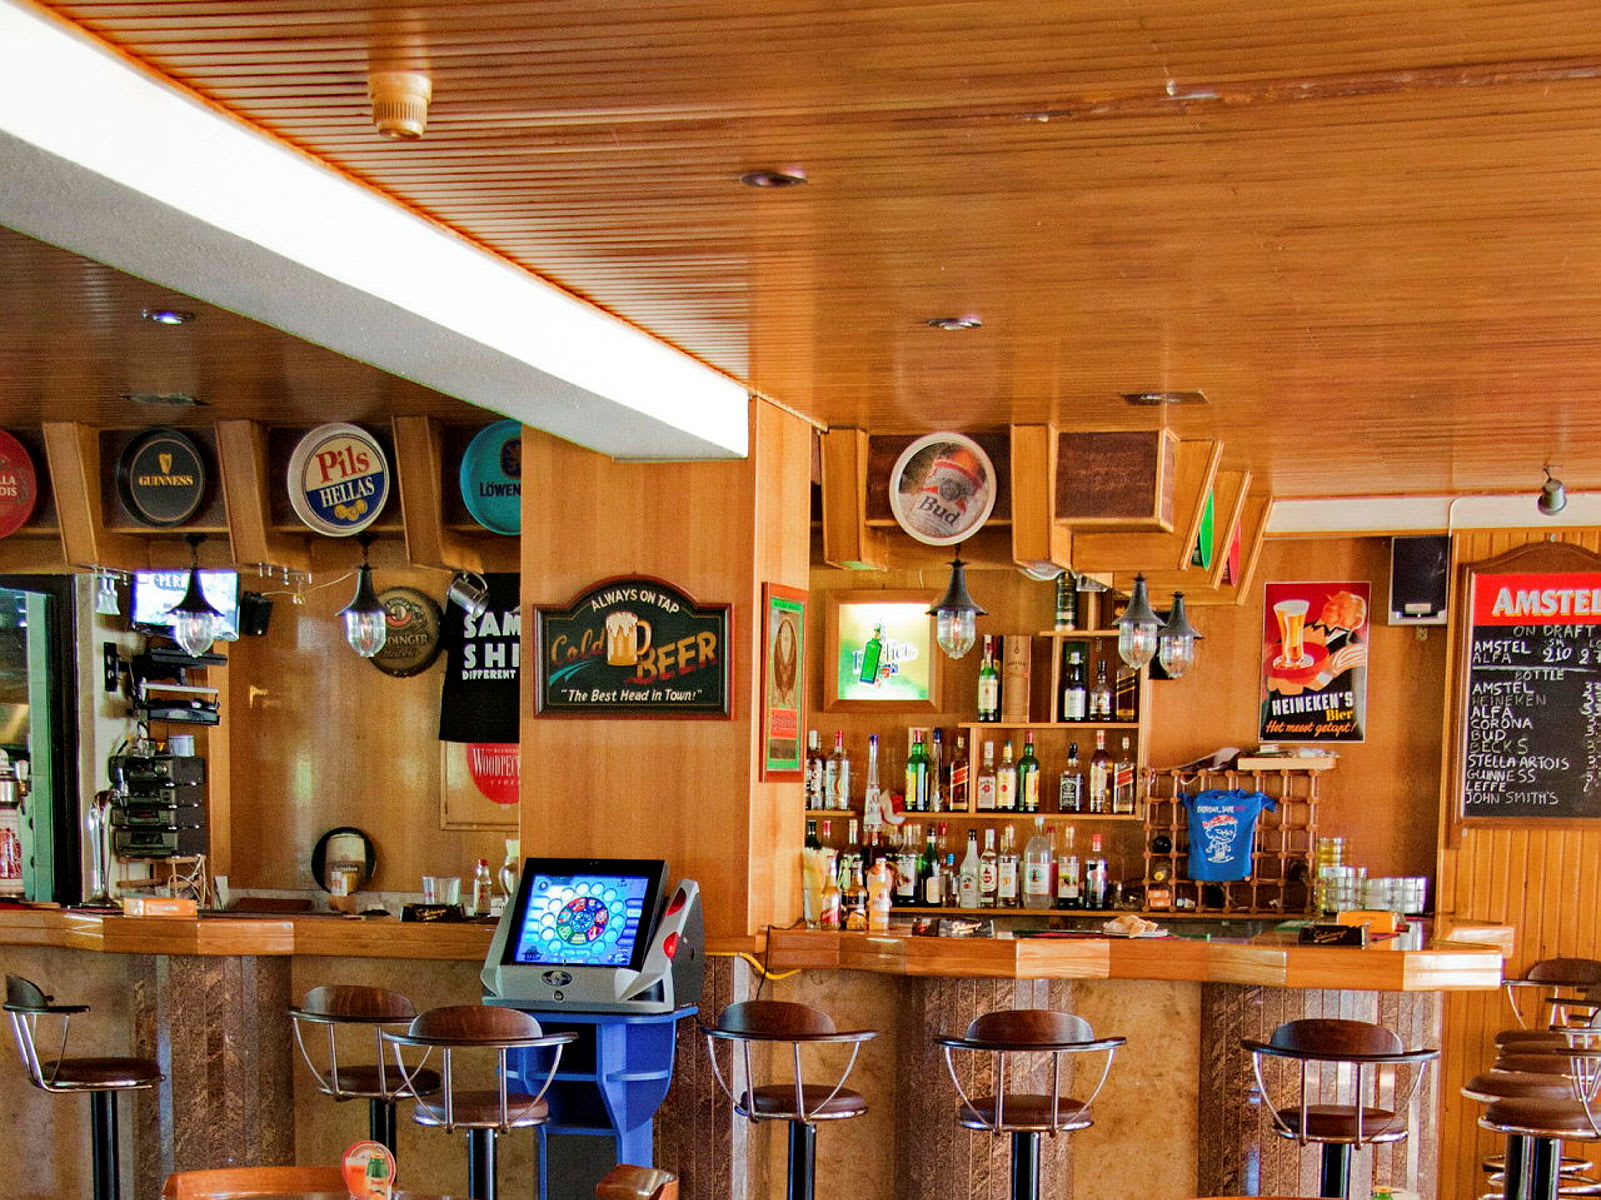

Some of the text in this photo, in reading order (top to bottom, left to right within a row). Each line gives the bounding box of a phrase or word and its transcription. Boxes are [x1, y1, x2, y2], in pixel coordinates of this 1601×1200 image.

[316, 445, 370, 484] Pils
[138, 475, 194, 487] GUINNESS
[319, 476, 375, 509] HELLAS
[919, 495, 961, 526] Bud
[590, 588, 680, 614] ALWAYS ON TAP
[1492, 587, 1601, 617] AMSTEL
[463, 611, 520, 639] SAM
[1513, 625, 1597, 638] ON DRAFT
[387, 634, 428, 645] DINGER
[1474, 640, 1531, 654] AMSTEL
[463, 643, 520, 669] SHI
[551, 628, 718, 683] Cold BEER
[1473, 652, 1512, 664] ALFA
[462, 669, 516, 680] DIFFERENT
[1515, 668, 1564, 681] BOTTLE
[591, 689, 617, 701] Best
[620, 689, 648, 701] Head
[651, 690, 662, 700] in
[1472, 682, 1535, 695] AMSTEL
[1271, 691, 1354, 716] HEINEKEN'S
[1472, 694, 1547, 707] HEINEKEN
[1325, 709, 1353, 721] Bier
[1470, 706, 1513, 720] ALFA
[1265, 721, 1285, 733] Het
[1471, 717, 1534, 729] CORONA
[1471, 729, 1507, 741] BUD
[1467, 754, 1570, 771] STELLA ARTOIS
[1466, 769, 1536, 783] GUINNESS
[1465, 781, 1507, 792] LEFFE
[1466, 792, 1500, 804] JOHN
